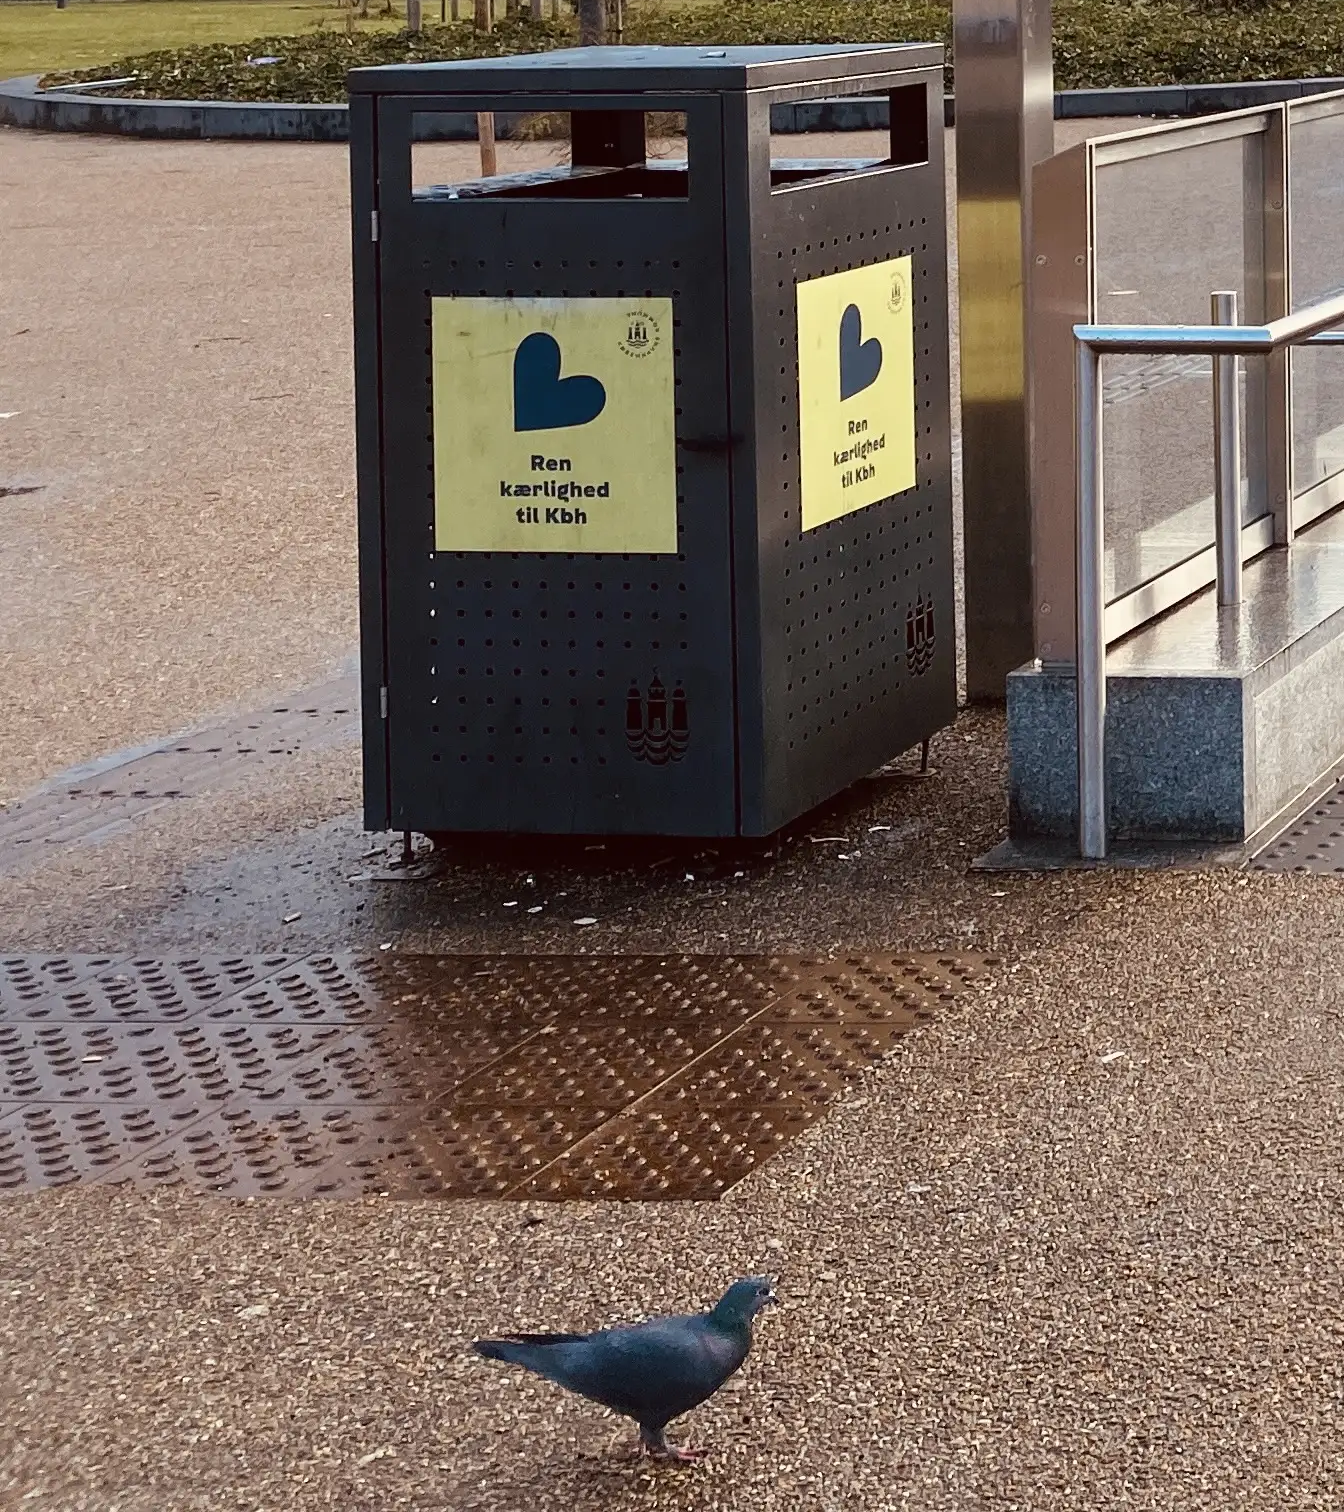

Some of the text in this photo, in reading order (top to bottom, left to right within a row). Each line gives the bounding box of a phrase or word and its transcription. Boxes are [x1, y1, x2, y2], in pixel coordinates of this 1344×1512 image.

[847, 417, 869, 437] Ren
[832, 433, 886, 468] kærlighed
[530, 455, 572, 472] Ren
[841, 464, 876, 489] til Kbh
[499, 480, 610, 503] kærlighed
[515, 506, 587, 525] til Kbh
